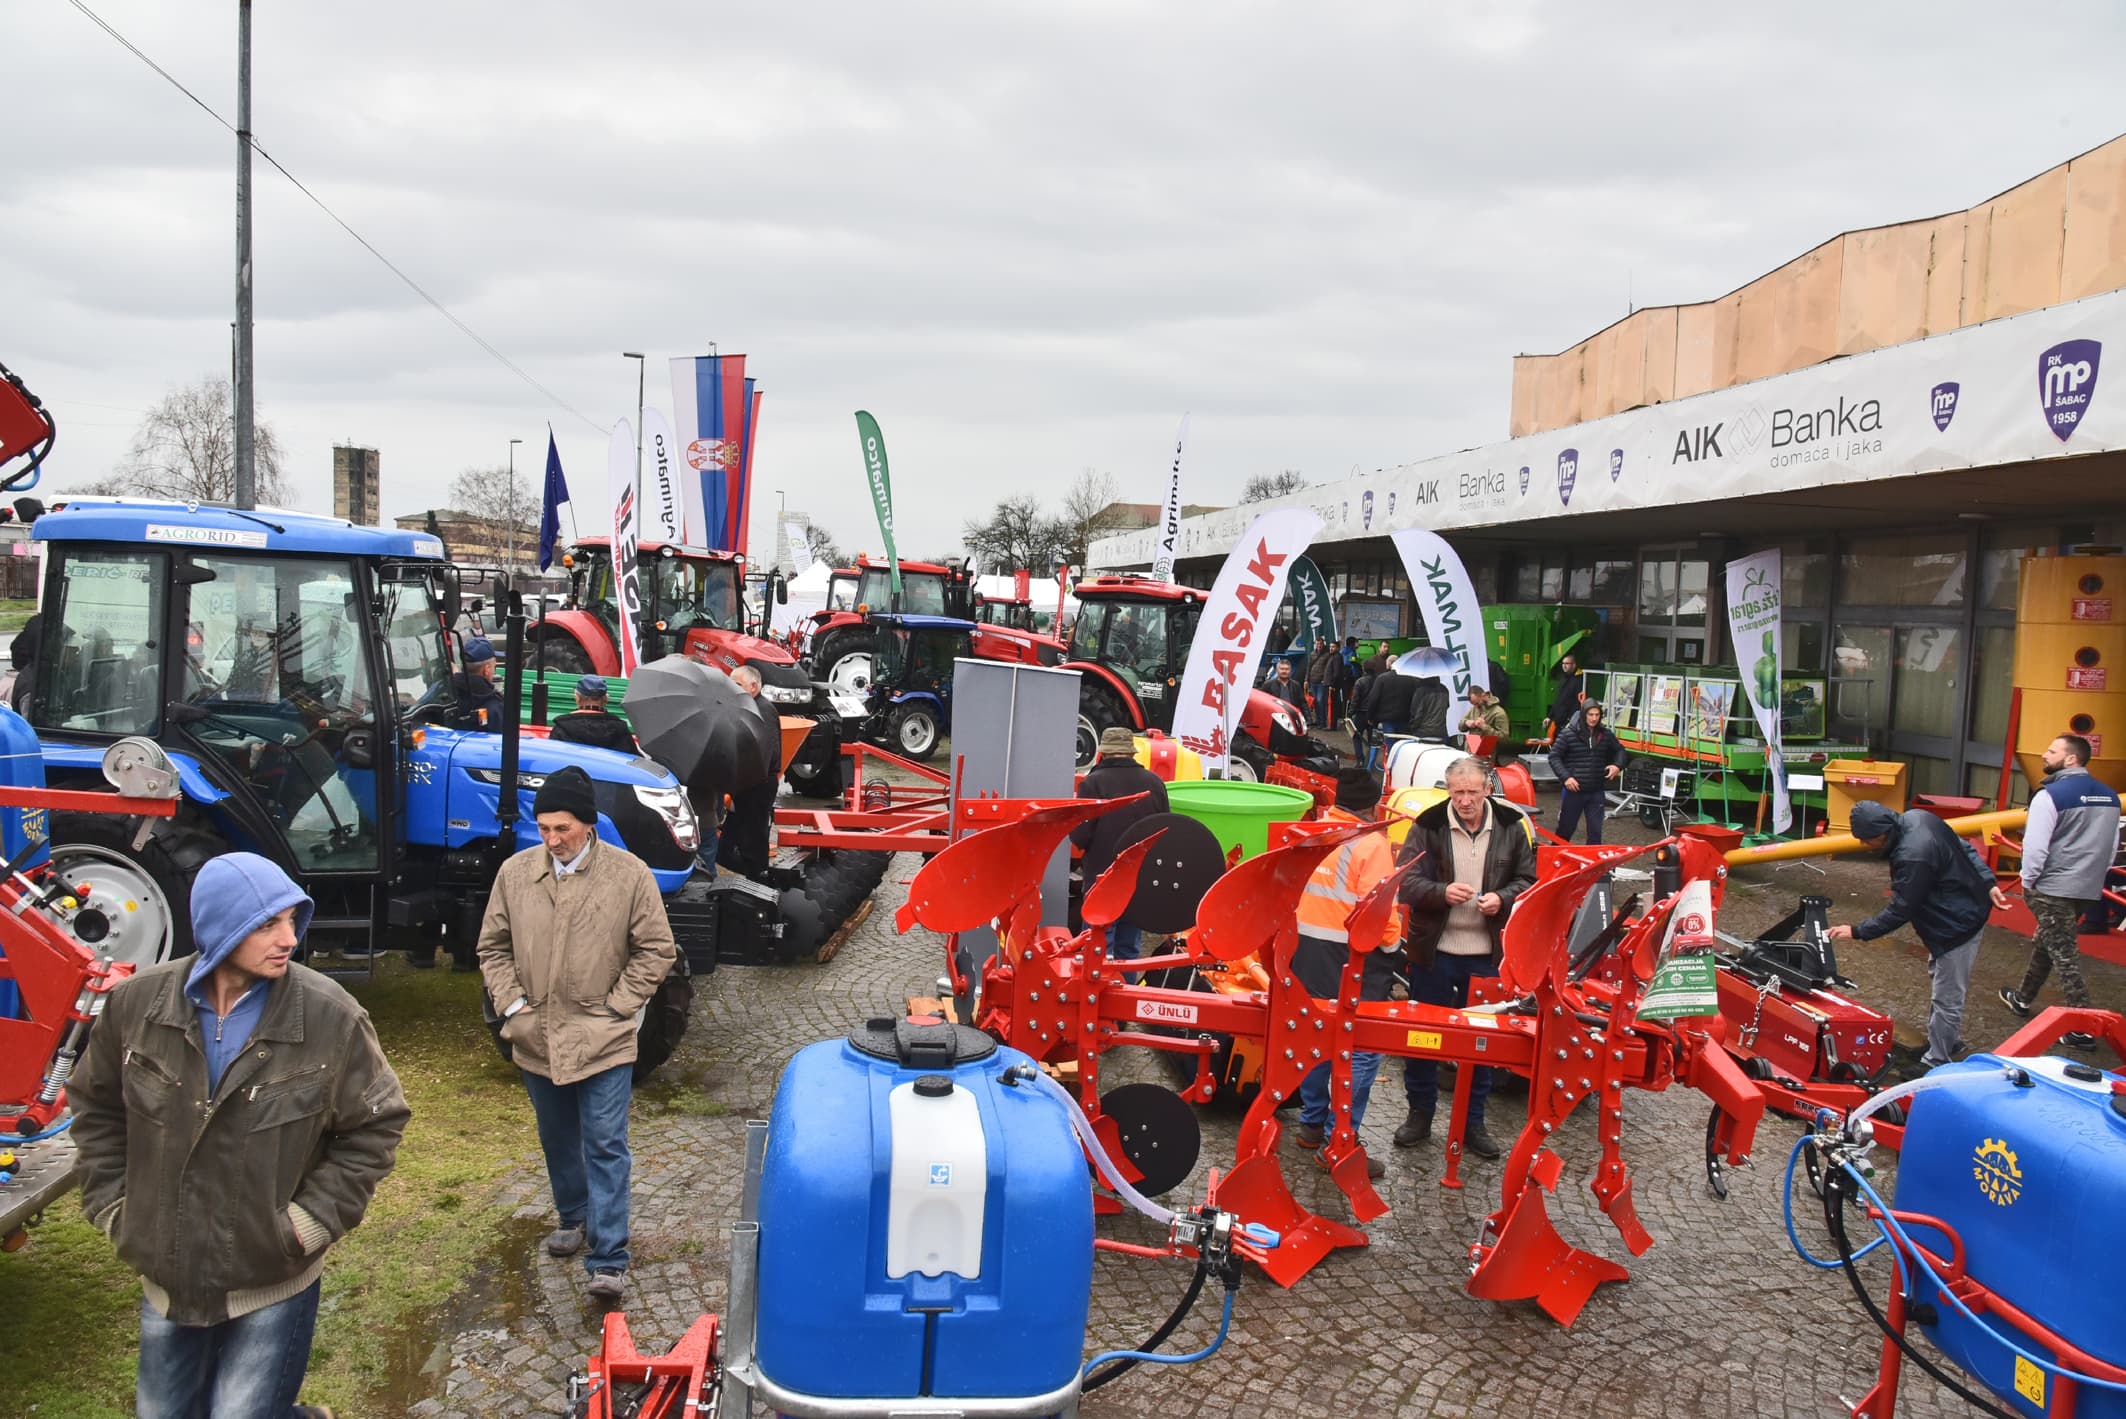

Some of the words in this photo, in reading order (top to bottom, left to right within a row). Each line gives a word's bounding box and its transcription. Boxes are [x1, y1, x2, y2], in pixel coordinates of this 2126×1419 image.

[2047, 354, 2062, 366] RK
[2055, 394, 2086, 407] ŠABAC
[2053, 411, 2077, 424] 1958
[1672, 422, 1724, 465] AIK
[1771, 396, 1883, 448] Banka
[1845, 439, 1883, 461] jaka
[1416, 480, 1439, 505] AIK
[1460, 468, 1505, 498] Banka
[162, 528, 236, 542] AGRORID
[1201, 536, 1288, 717] BASAK
[1158, 1004, 1191, 1019] ÜNLÜ
[1869, 1032, 1884, 1044] CE
[1973, 1167, 2021, 1206] MORAVA
